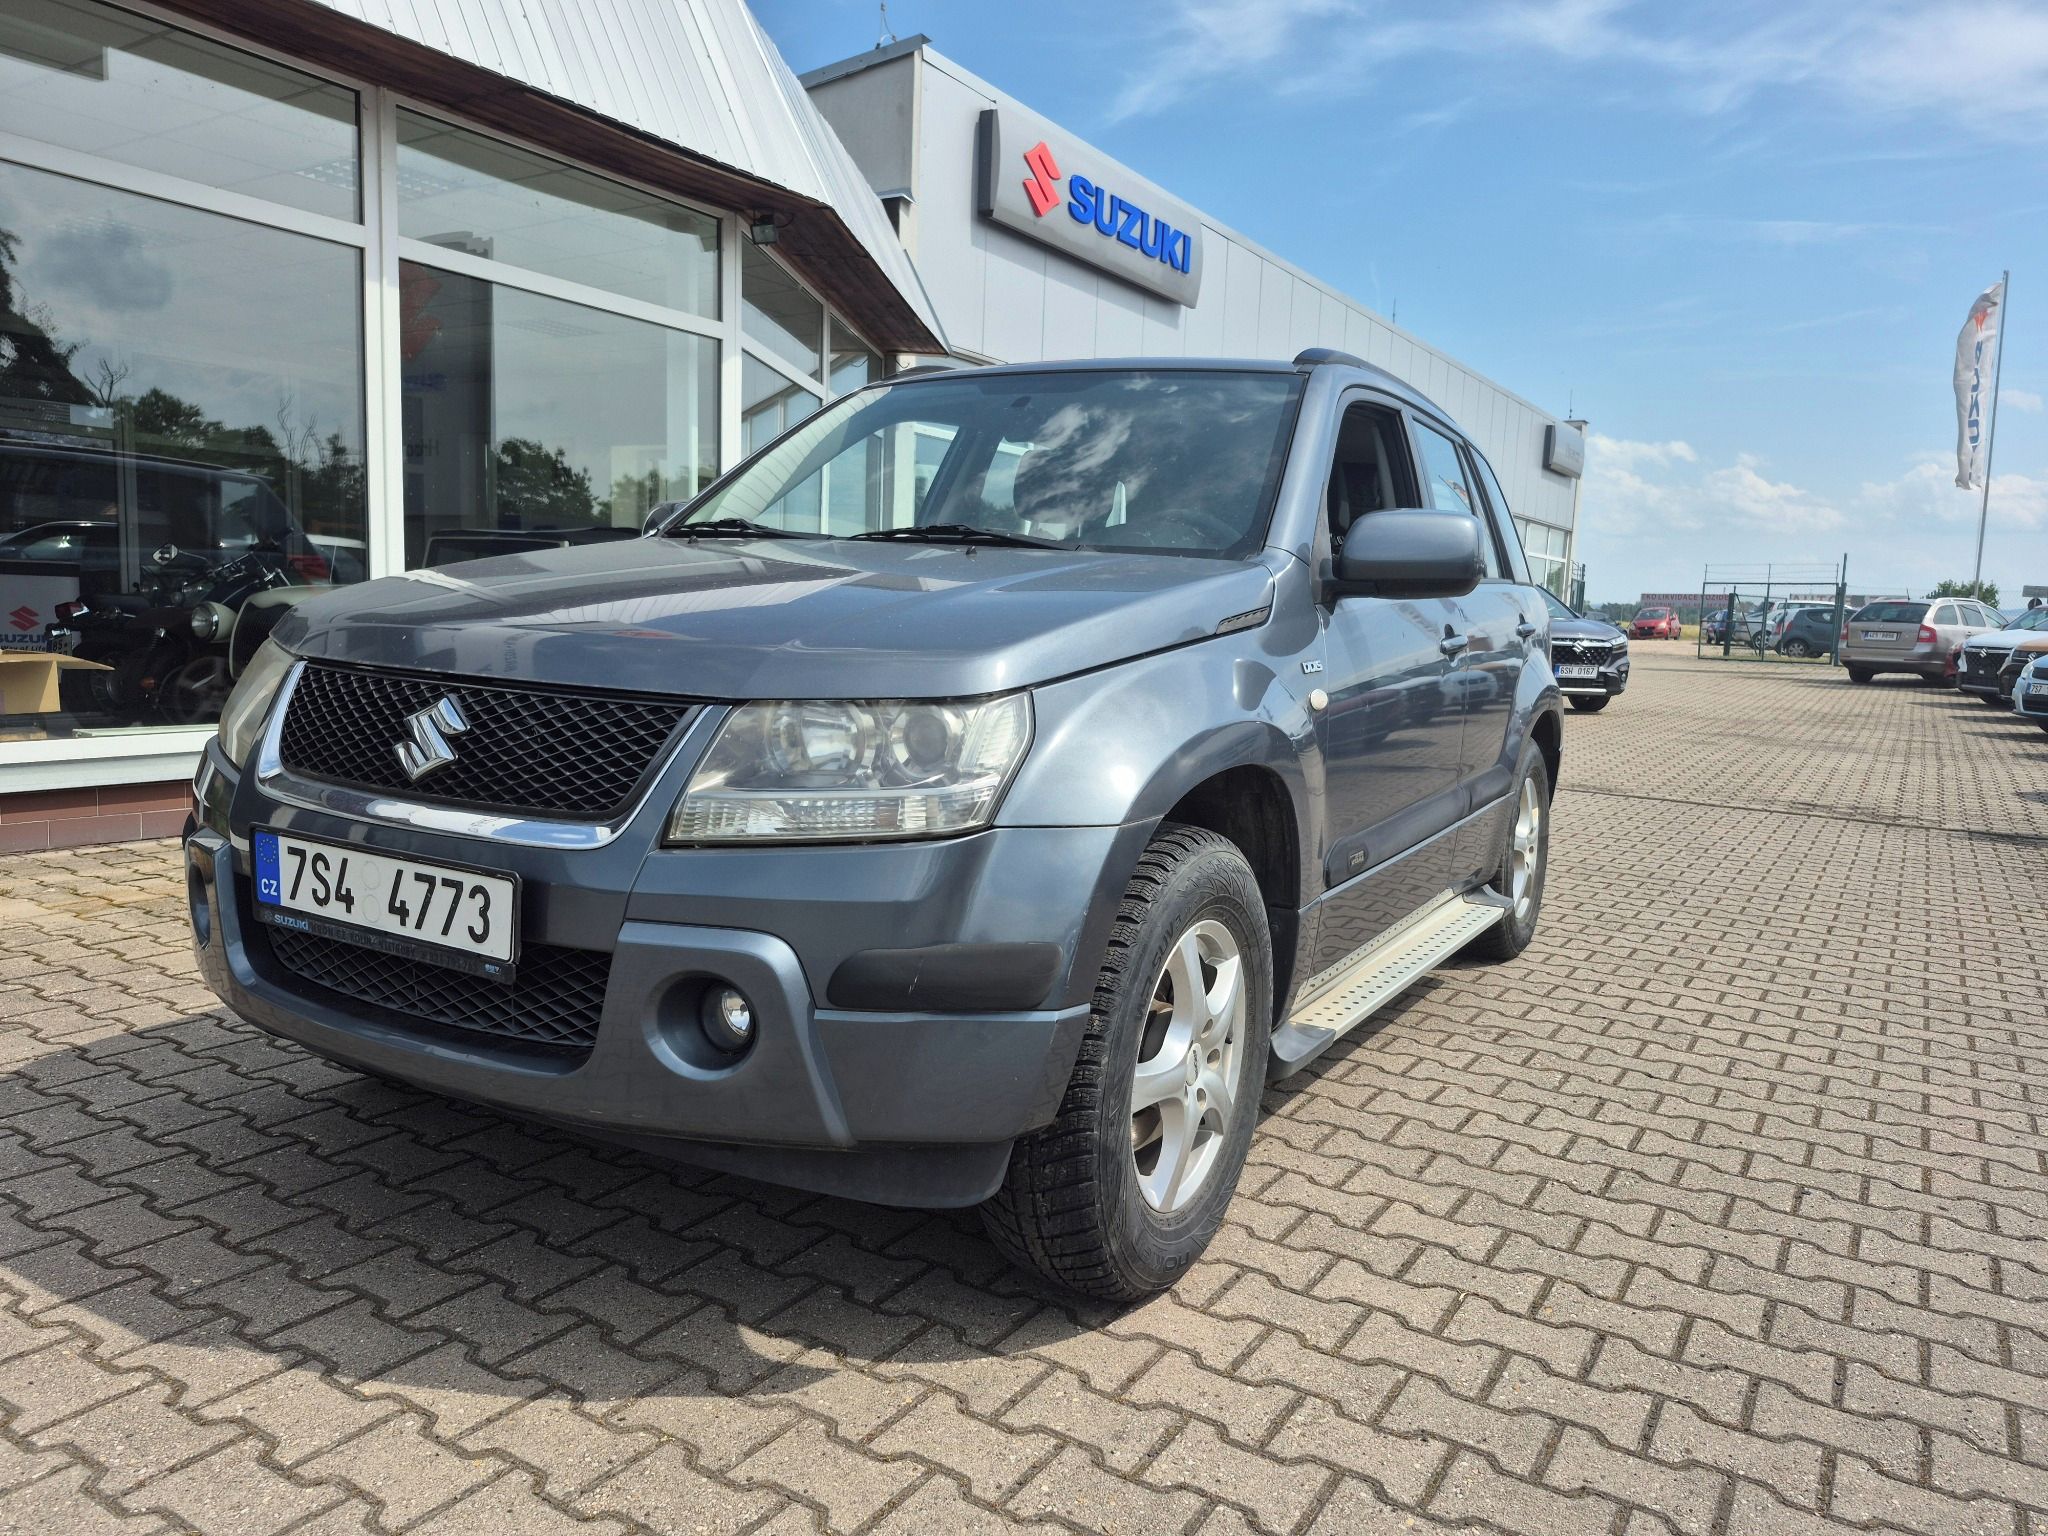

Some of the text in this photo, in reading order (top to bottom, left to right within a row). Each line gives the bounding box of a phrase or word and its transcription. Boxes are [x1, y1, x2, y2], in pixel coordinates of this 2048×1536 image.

[1068, 174, 1192, 274] SUZUKI
[1659, 593, 1698, 601] LIKVIDACE
[261, 878, 278, 896] CZ
[287, 846, 491, 944] 7S4 4773
[273, 913, 309, 931] SUZUKI
